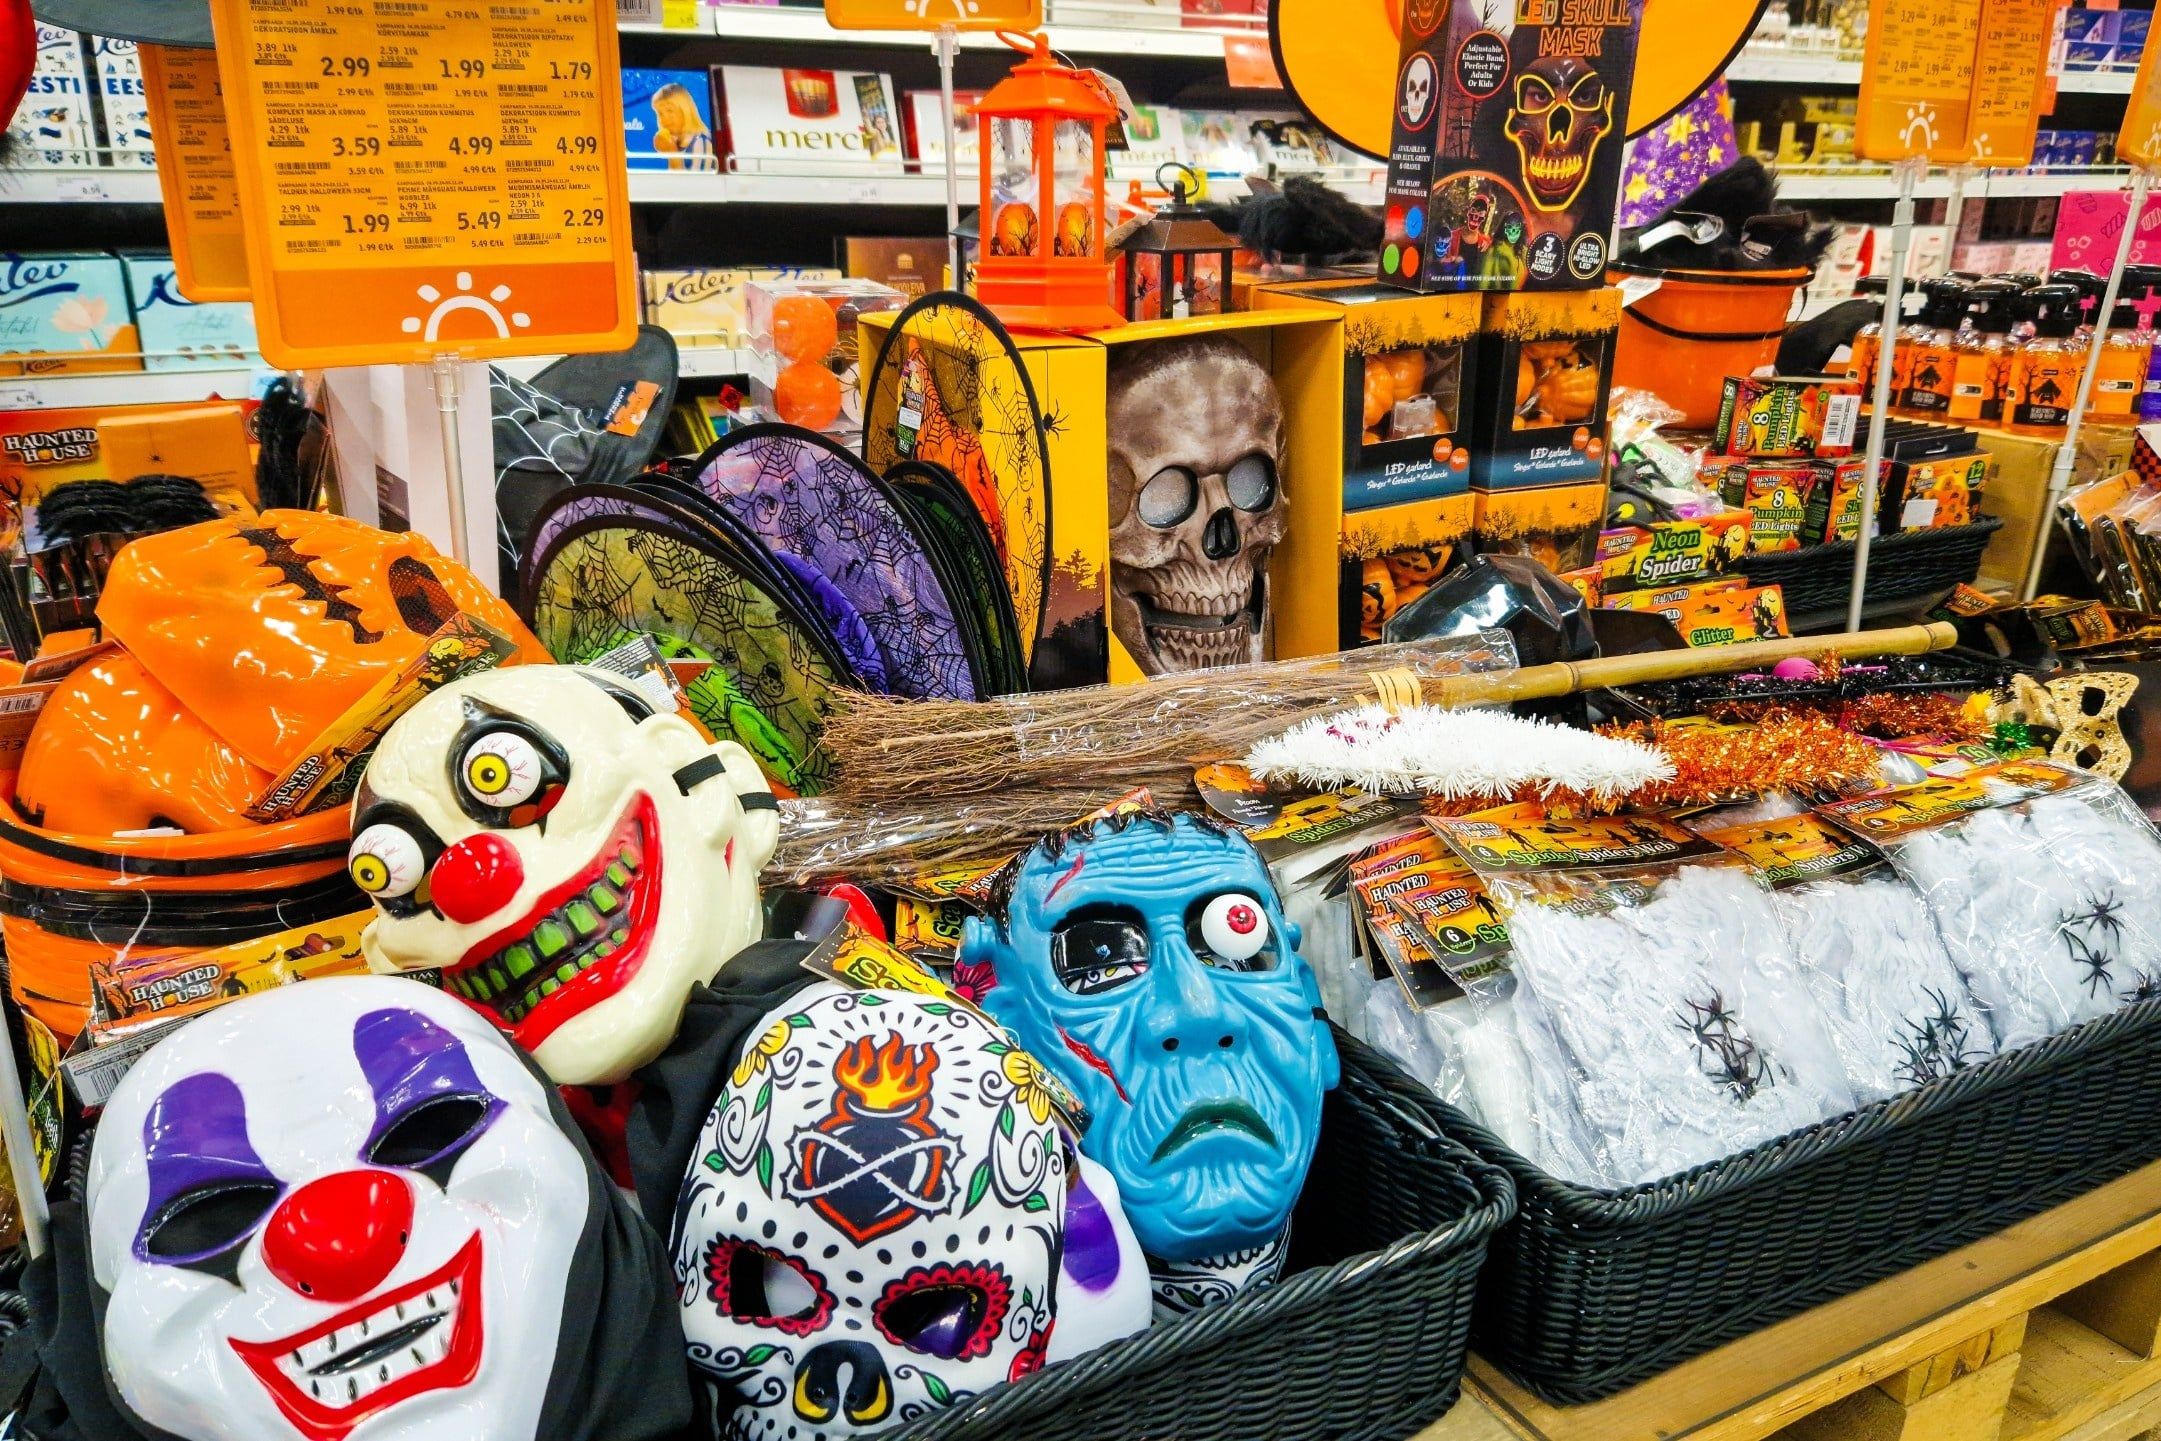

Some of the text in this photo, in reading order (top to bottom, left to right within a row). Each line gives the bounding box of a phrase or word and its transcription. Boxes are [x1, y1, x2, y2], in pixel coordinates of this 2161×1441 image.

[1561, 0, 1632, 25] SKULL
[1466, 45, 1502, 53] Adjustable
[1539, 27, 1604, 56] MASK
[320, 56, 370, 76] 2.99
[1462, 53, 1483, 61] Elastic
[1464, 62, 1488, 70] Perfect
[440, 59, 485, 78] 1.99
[550, 61, 592, 80] 1.79
[1471, 71, 1493, 79] Adults
[28, 77, 81, 94] ESTI
[106, 78, 145, 95] EES
[332, 137, 380, 156] 3.59
[449, 136, 493, 155] 4.99
[557, 136, 597, 154] 4.99
[766, 125, 869, 150] merci
[342, 214, 390, 233] 1.99
[458, 211, 501, 230] 5.49
[564, 208, 604, 227] 2.29
[1543, 237, 1555, 252] 3
[1577, 249, 1600, 258] BRIGHT
[1579, 243, 1599, 251] ULTRA
[1535, 250, 1557, 260] SCARY
[1535, 258, 1553, 267] LIGHT
[1573, 256, 1600, 265] HI-GLOW
[1752, 412, 1769, 424] 8
[1763, 386, 1785, 450] Pumpkin
[1777, 389, 1797, 448] LED Lights
[5, 429, 98, 450] HAUNTED
[24, 444, 90, 463] HOUSE
[1530, 447, 1549, 460] LED
[1385, 459, 1432, 476] LED garland
[1968, 462, 1985, 478] 12
[1752, 475, 1782, 483] HAUNTED
[1773, 490, 1785, 508] 8
[1750, 507, 1803, 520] Pumpkin
[1770, 522, 1800, 532] Lights
[1604, 535, 1638, 548] HAUNTED
[1653, 530, 1699, 551] Neon
[1640, 555, 1700, 580] Spider
[1653, 589, 1689, 605] HAUNTED
[1691, 628, 1734, 645] Glitter
[263, 756, 319, 811] HAUNTED
[282, 766, 322, 806] HOUSE
[1290, 817, 1348, 842] Spiders
[1362, 805, 1393, 822] Web
[1448, 822, 1499, 832] HAUNTED
[1870, 818, 1884, 827] 6
[1479, 846, 1490, 858] 6
[1510, 842, 1676, 865] Spooky Spiders Web
[1800, 852, 1857, 872] Spiders
[1372, 874, 1429, 902] HAUNTED
[1415, 888, 1468, 910] HAUNTED
[1431, 898, 1471, 917] HOUSE
[1446, 929, 1459, 943] 6
[132, 964, 220, 1002] HAUNTED
[151, 982, 215, 1011] HOUSE
